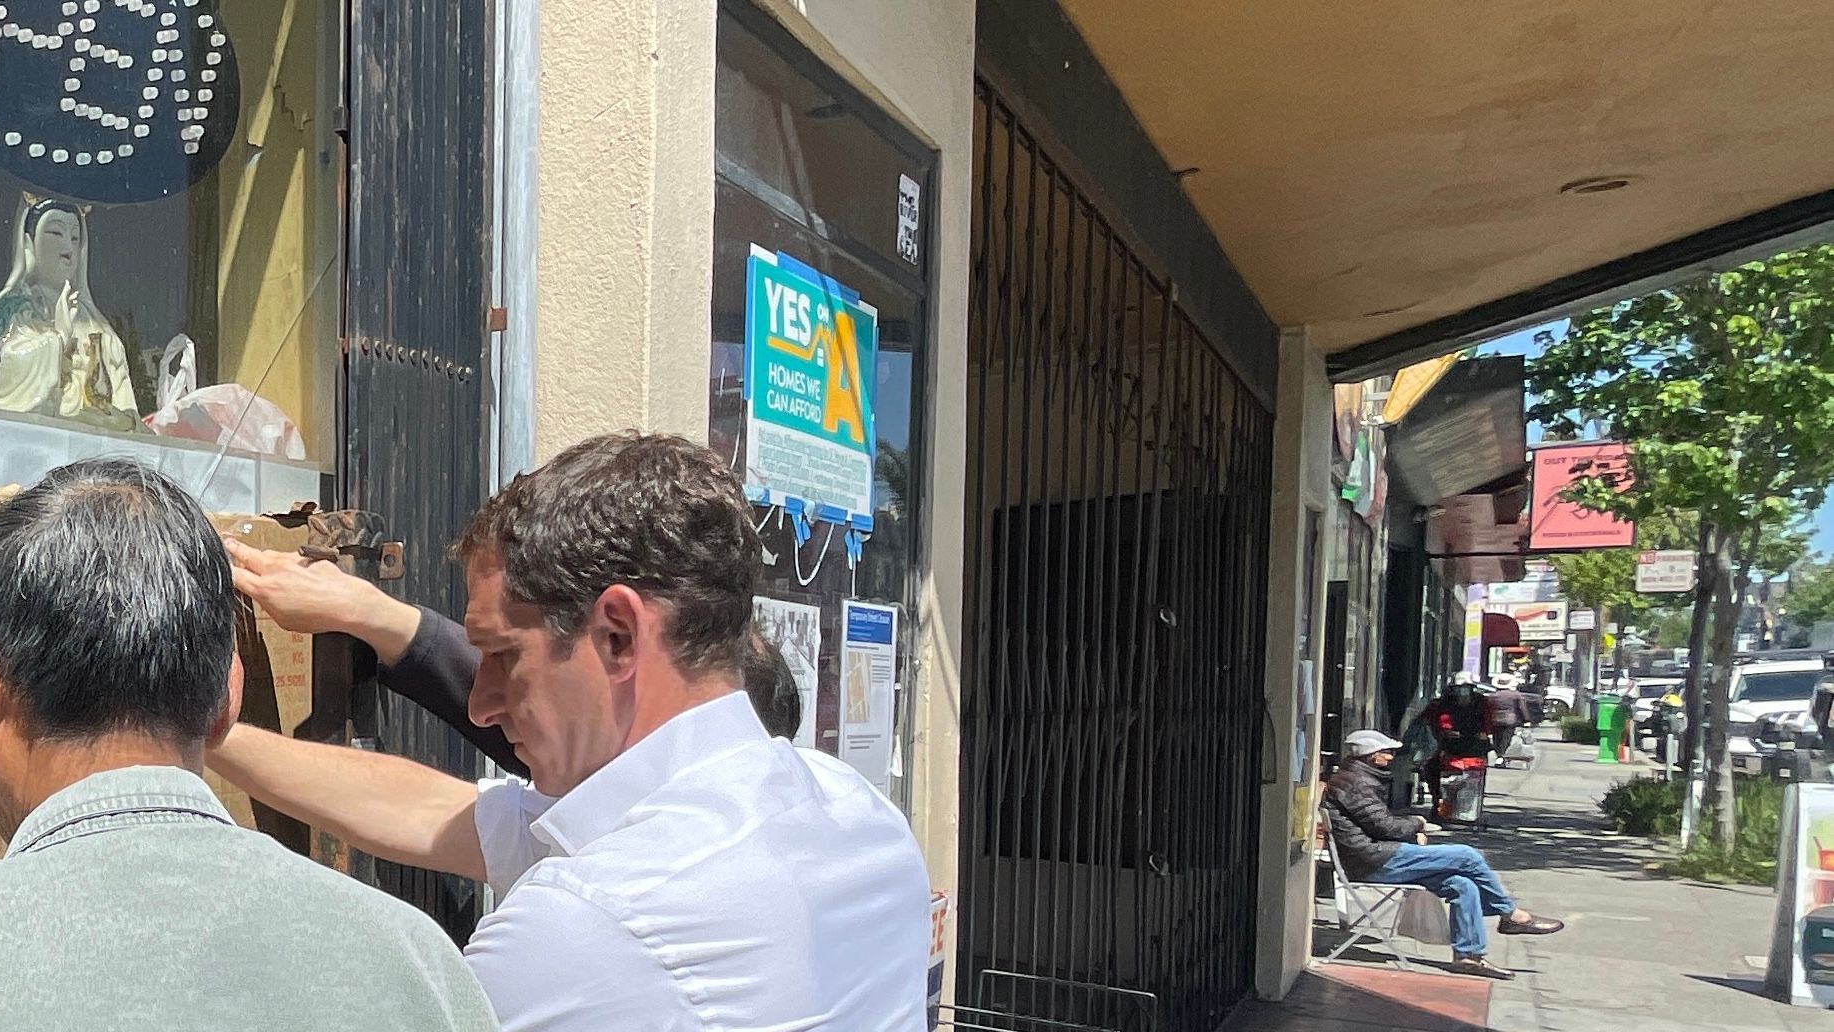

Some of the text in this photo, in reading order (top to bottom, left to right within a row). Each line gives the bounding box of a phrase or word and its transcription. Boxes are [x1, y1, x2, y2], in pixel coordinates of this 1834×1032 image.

[765, 277, 865, 444] YES ON A
[768, 362, 822, 401] HOMES WE
[767, 389, 822, 424] CAN AFFORD
